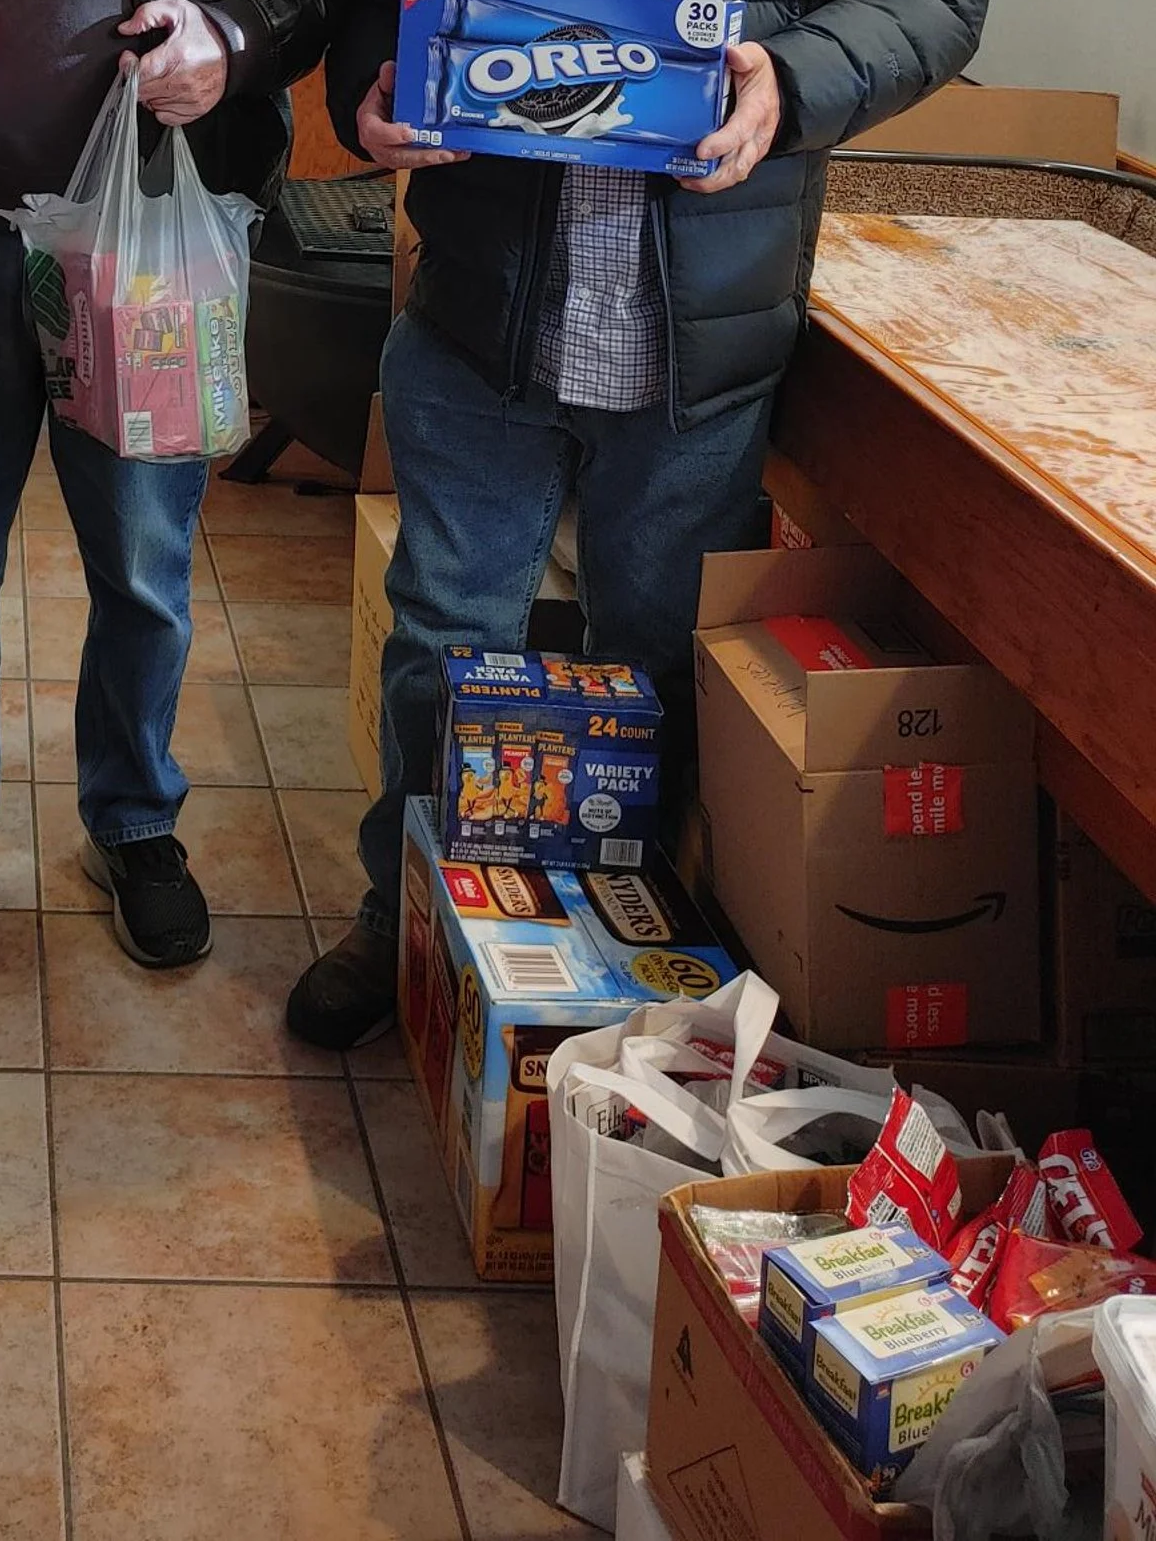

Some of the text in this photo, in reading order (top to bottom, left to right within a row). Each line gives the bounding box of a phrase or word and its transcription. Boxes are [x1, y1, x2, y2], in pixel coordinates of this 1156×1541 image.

[688, 1, 718, 22] 30
[686, 21, 719, 32] PACKS
[467, 41, 656, 95] OREO
[451, 105, 461, 117] 6
[464, 671, 532, 683] VARIETY
[460, 684, 542, 698] PLANTERS
[588, 714, 657, 740] 24 COUNT
[897, 708, 943, 738] 128
[585, 763, 654, 780] VARIETY
[597, 777, 641, 792] PACK
[907, 768, 924, 787] le
[929, 765, 945, 834] mile mo
[607, 874, 662, 938] NYDER'S
[667, 959, 714, 989] 60
[524, 1060, 547, 1077] SN
[814, 1242, 890, 1272] Breakfast
[862, 1309, 941, 1341] Breakfast
[883, 1325, 949, 1351] Blueberry
[894, 1387, 955, 1428] Breakf
[898, 1419, 935, 1445] Blue
